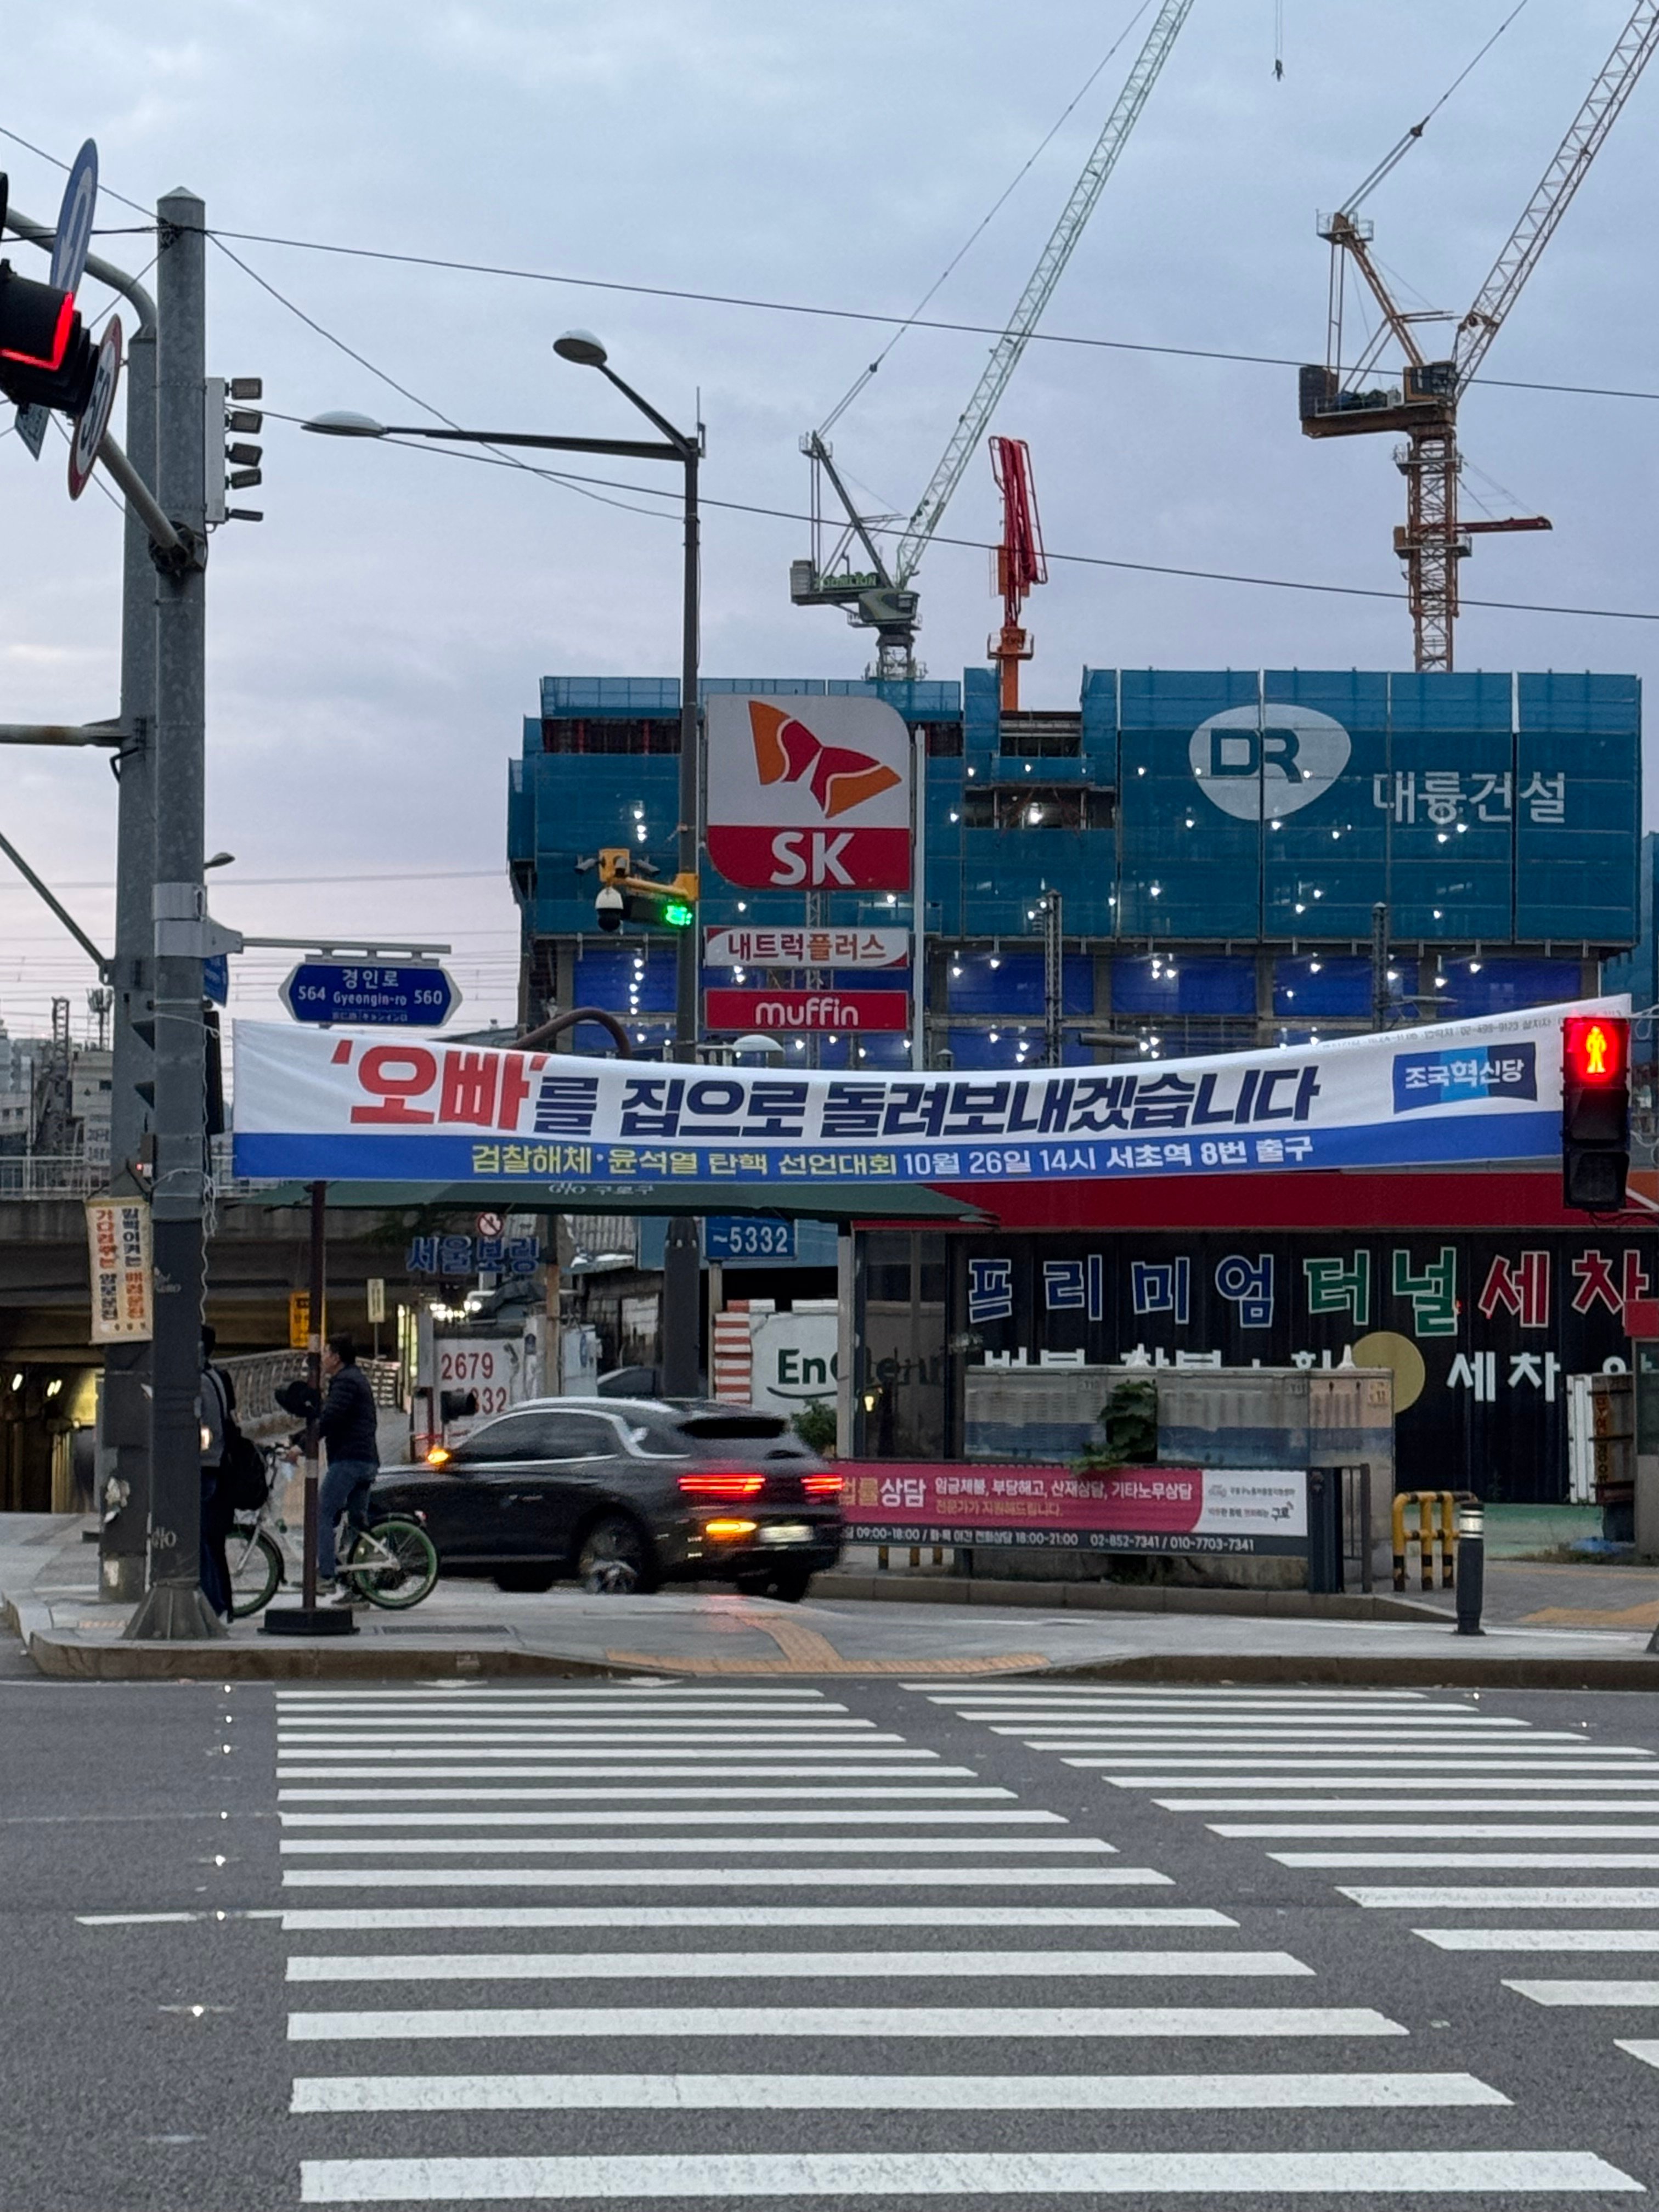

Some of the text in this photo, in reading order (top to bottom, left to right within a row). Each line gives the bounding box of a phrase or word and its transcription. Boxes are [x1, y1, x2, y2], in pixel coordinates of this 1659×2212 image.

[1211, 728, 1302, 783] DR
[1373, 771, 1565, 823] 대륭건설
[771, 832, 855, 885] SK
[728, 934, 885, 961] 내트럭플러스
[298, 986, 325, 1000] 564
[342, 969, 399, 989] 경인로
[333, 991, 407, 1006] Gyeongin-ro
[414, 990, 442, 1005] 560
[755, 998, 859, 1026] muffin
[1404, 1059, 1524, 1089] 조국혁신당
[620, 1079, 809, 1137] 집으로
[820, 1065, 1321, 1137] 돌려보내겠습니다
[708, 1152, 767, 1176] 탄핵
[778, 1153, 896, 1176] 선언대회
[904, 1152, 960, 1175] 10월
[969, 1150, 1031, 1173] 26일
[1040, 1148, 1096, 1171] 14시
[1106, 1142, 1192, 1170] 서초역
[1201, 1139, 1248, 1165] 8번
[1256, 1136, 1313, 1163] 출구
[406, 1235, 539, 1274] 서울보링
[968, 1246, 1649, 1338] 프리미엄 터널 세차
[442, 1352, 493, 1380] 2679
[1446, 1352, 1561, 1403] 세차
